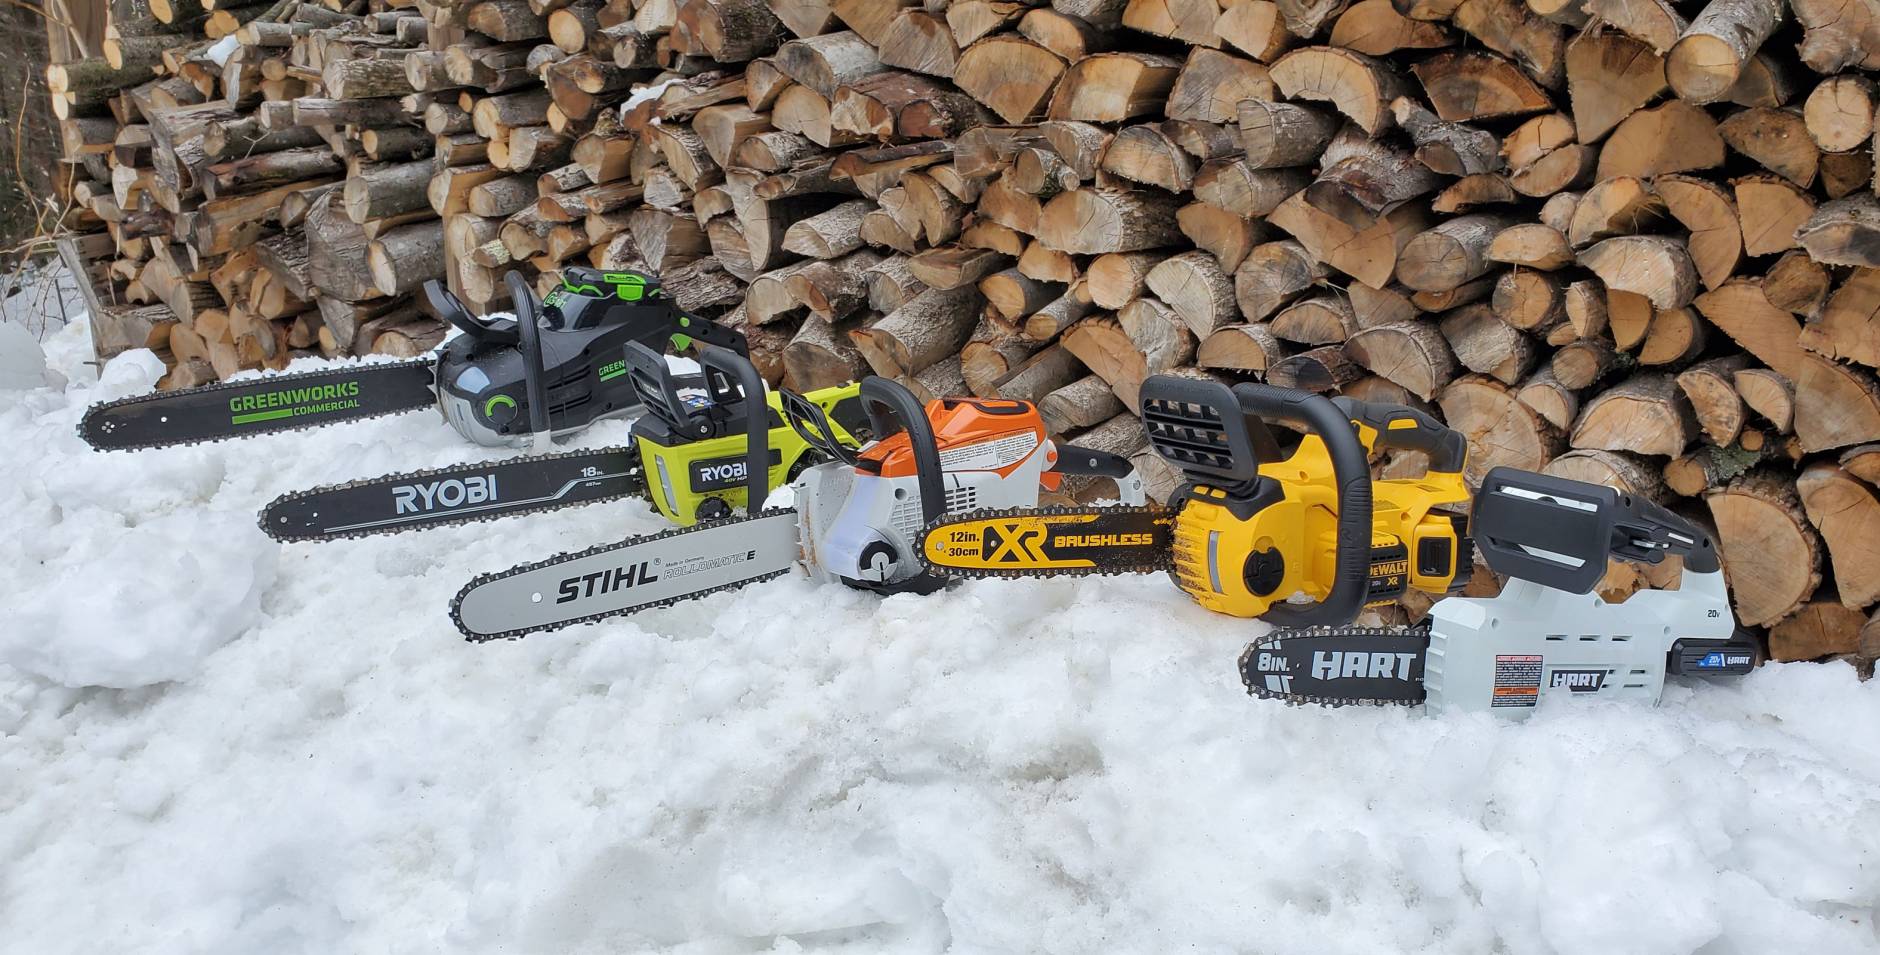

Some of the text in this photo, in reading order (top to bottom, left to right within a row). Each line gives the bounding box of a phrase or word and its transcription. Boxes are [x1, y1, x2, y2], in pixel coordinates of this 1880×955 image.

[230, 381, 359, 412] GREENWORKS
[294, 399, 360, 416] COMMERCIAL
[700, 462, 748, 482] RYOBI
[391, 474, 498, 515] RYOBI
[949, 531, 980, 543] 12in.
[985, 522, 1050, 562] XR
[1054, 533, 1153, 548] BRUSHLESS
[948, 547, 979, 557] 30cm
[663, 550, 756, 580] ROLLOMATIC E
[556, 561, 659, 605] STIHL
[1311, 650, 1417, 682] HART
[1726, 656, 1751, 665] HART
[1552, 673, 1601, 687] HART
